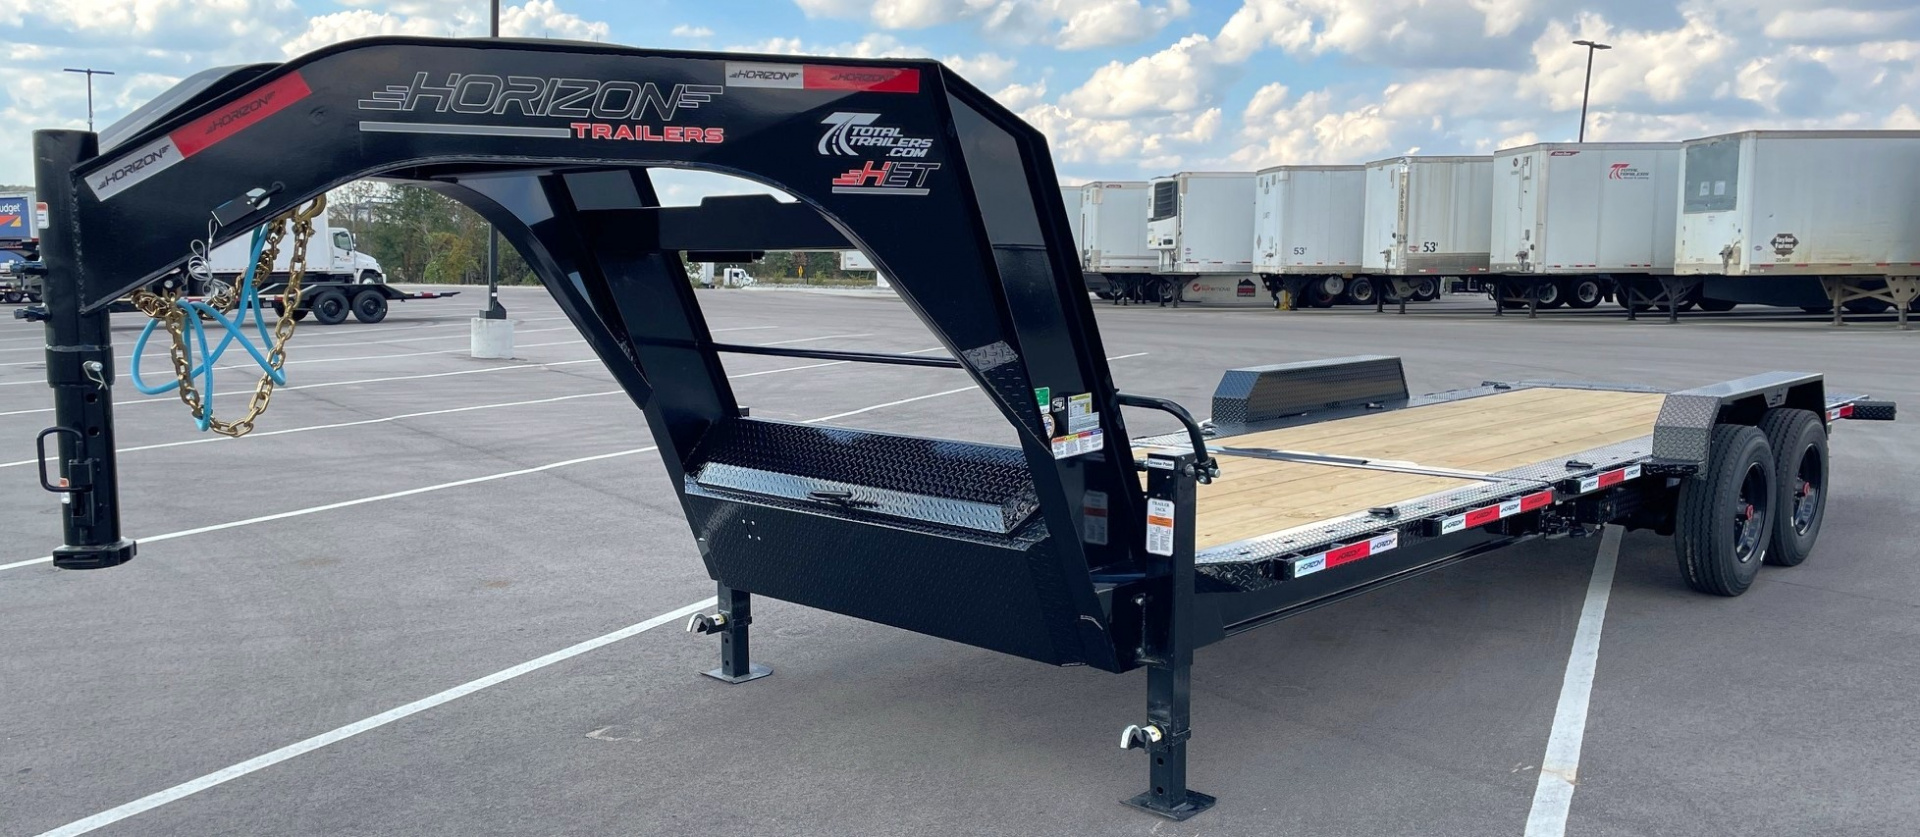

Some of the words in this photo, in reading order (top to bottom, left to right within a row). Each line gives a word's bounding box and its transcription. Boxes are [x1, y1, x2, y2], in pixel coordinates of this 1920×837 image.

[736, 70, 791, 81] HORIZON
[401, 71, 687, 121] HORIZON
[211, 95, 270, 132] HORIZON
[569, 122, 725, 144] TRAILERS
[852, 125, 904, 138] TOTAL
[849, 136, 934, 148] TRAILERS
[885, 147, 929, 158] .COM
[103, 147, 165, 188] HORIZON
[855, 160, 942, 188] HET
[0, 202, 21, 216] udget
